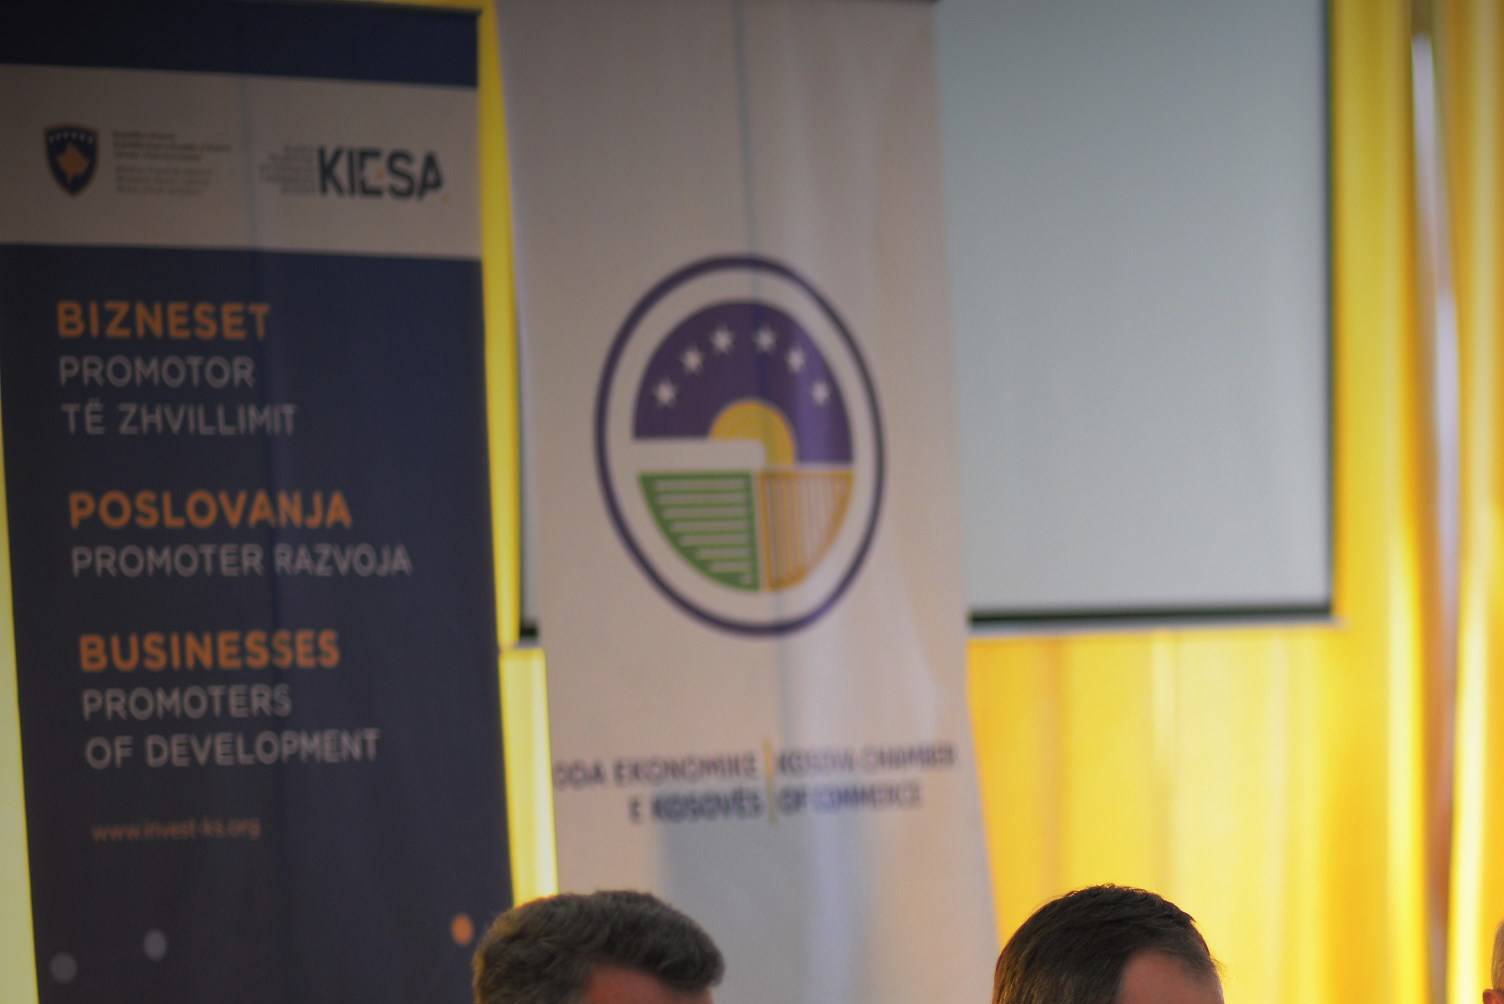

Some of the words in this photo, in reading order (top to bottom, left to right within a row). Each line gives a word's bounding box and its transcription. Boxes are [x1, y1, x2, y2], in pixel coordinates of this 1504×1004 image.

[318, 145, 444, 200] KIESA
[57, 301, 270, 340] BIZNESET
[59, 356, 254, 388] PROMOTOR
[62, 400, 105, 435] TË
[118, 403, 298, 436] ZHVILLIMIT
[68, 490, 351, 529] POSLOVANJA
[71, 543, 263, 577] PROMOTER
[274, 542, 413, 577] RAZVOJA
[79, 629, 340, 672] BUSINESSES
[82, 684, 292, 720] PROMOTERS
[85, 736, 133, 768] OF
[146, 728, 381, 767] DEVELOPMENT
[92, 818, 261, 843] www.invest-ks.org
